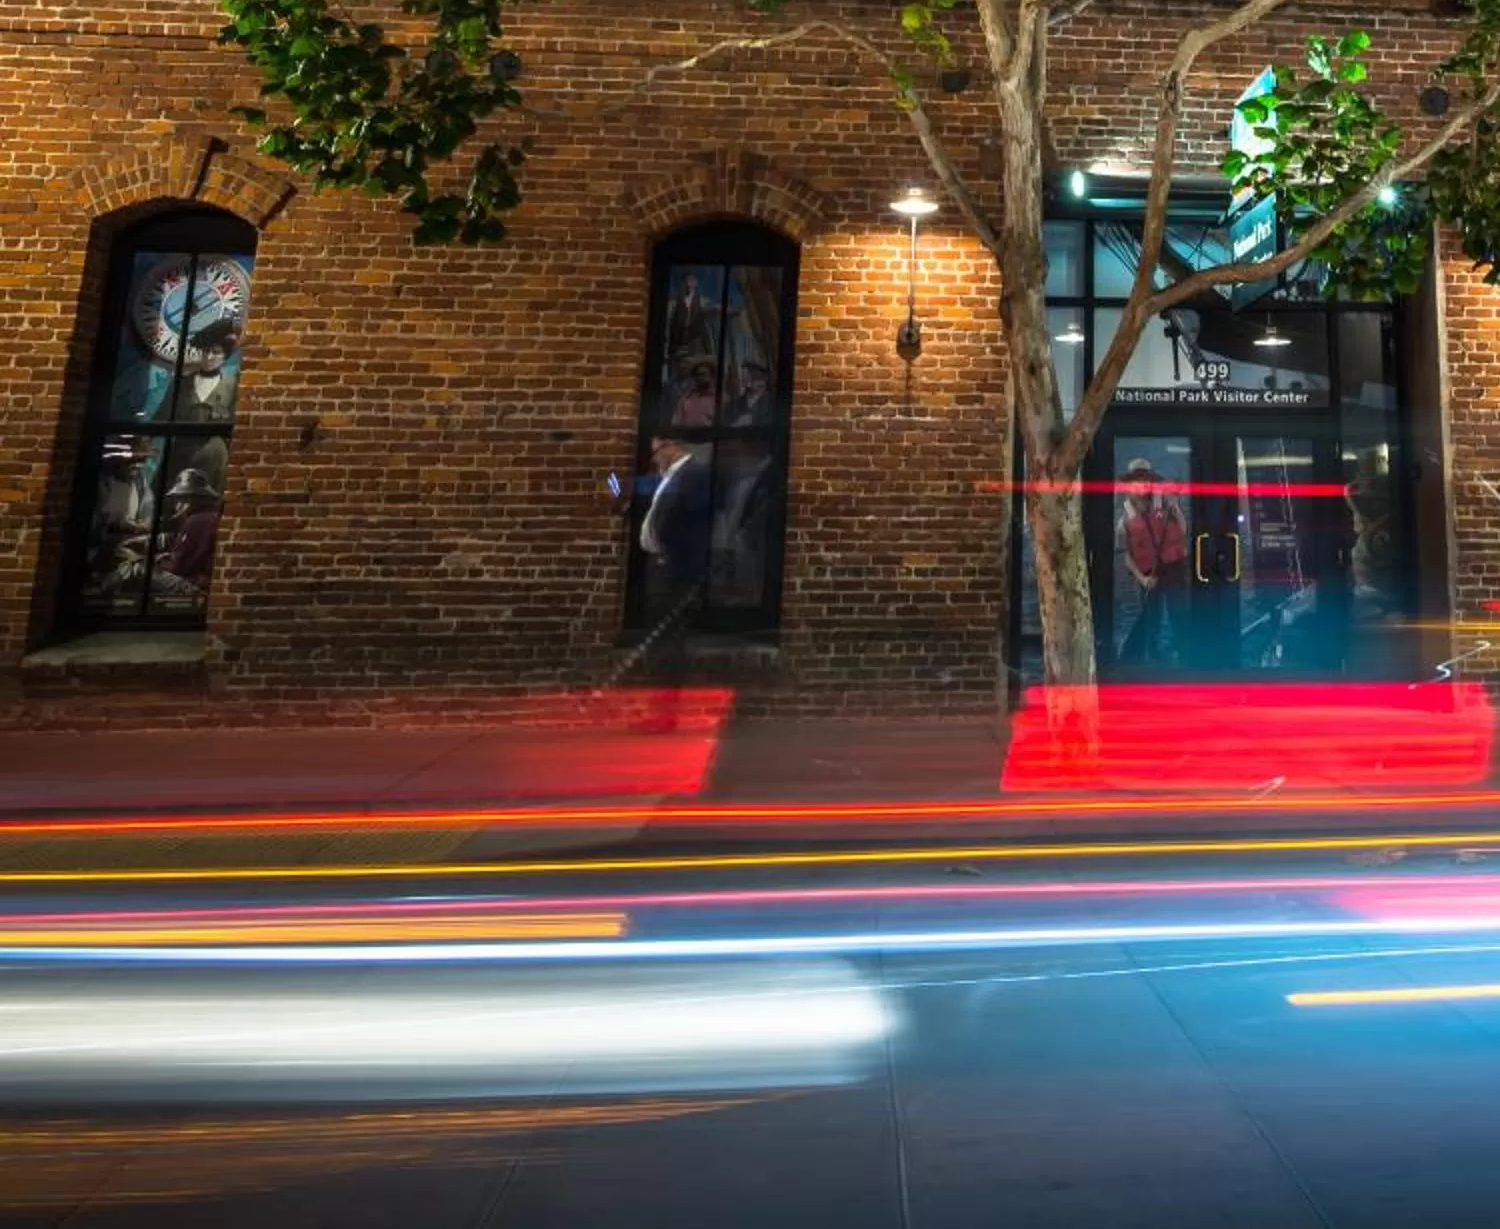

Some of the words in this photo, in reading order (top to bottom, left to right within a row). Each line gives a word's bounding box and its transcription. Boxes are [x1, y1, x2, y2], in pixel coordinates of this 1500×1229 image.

[1197, 362, 1229, 379] 499
[1116, 389, 1175, 403] National
[1179, 389, 1209, 403] Park
[1214, 390, 1259, 403] Visitor
[1263, 390, 1310, 404] Center
